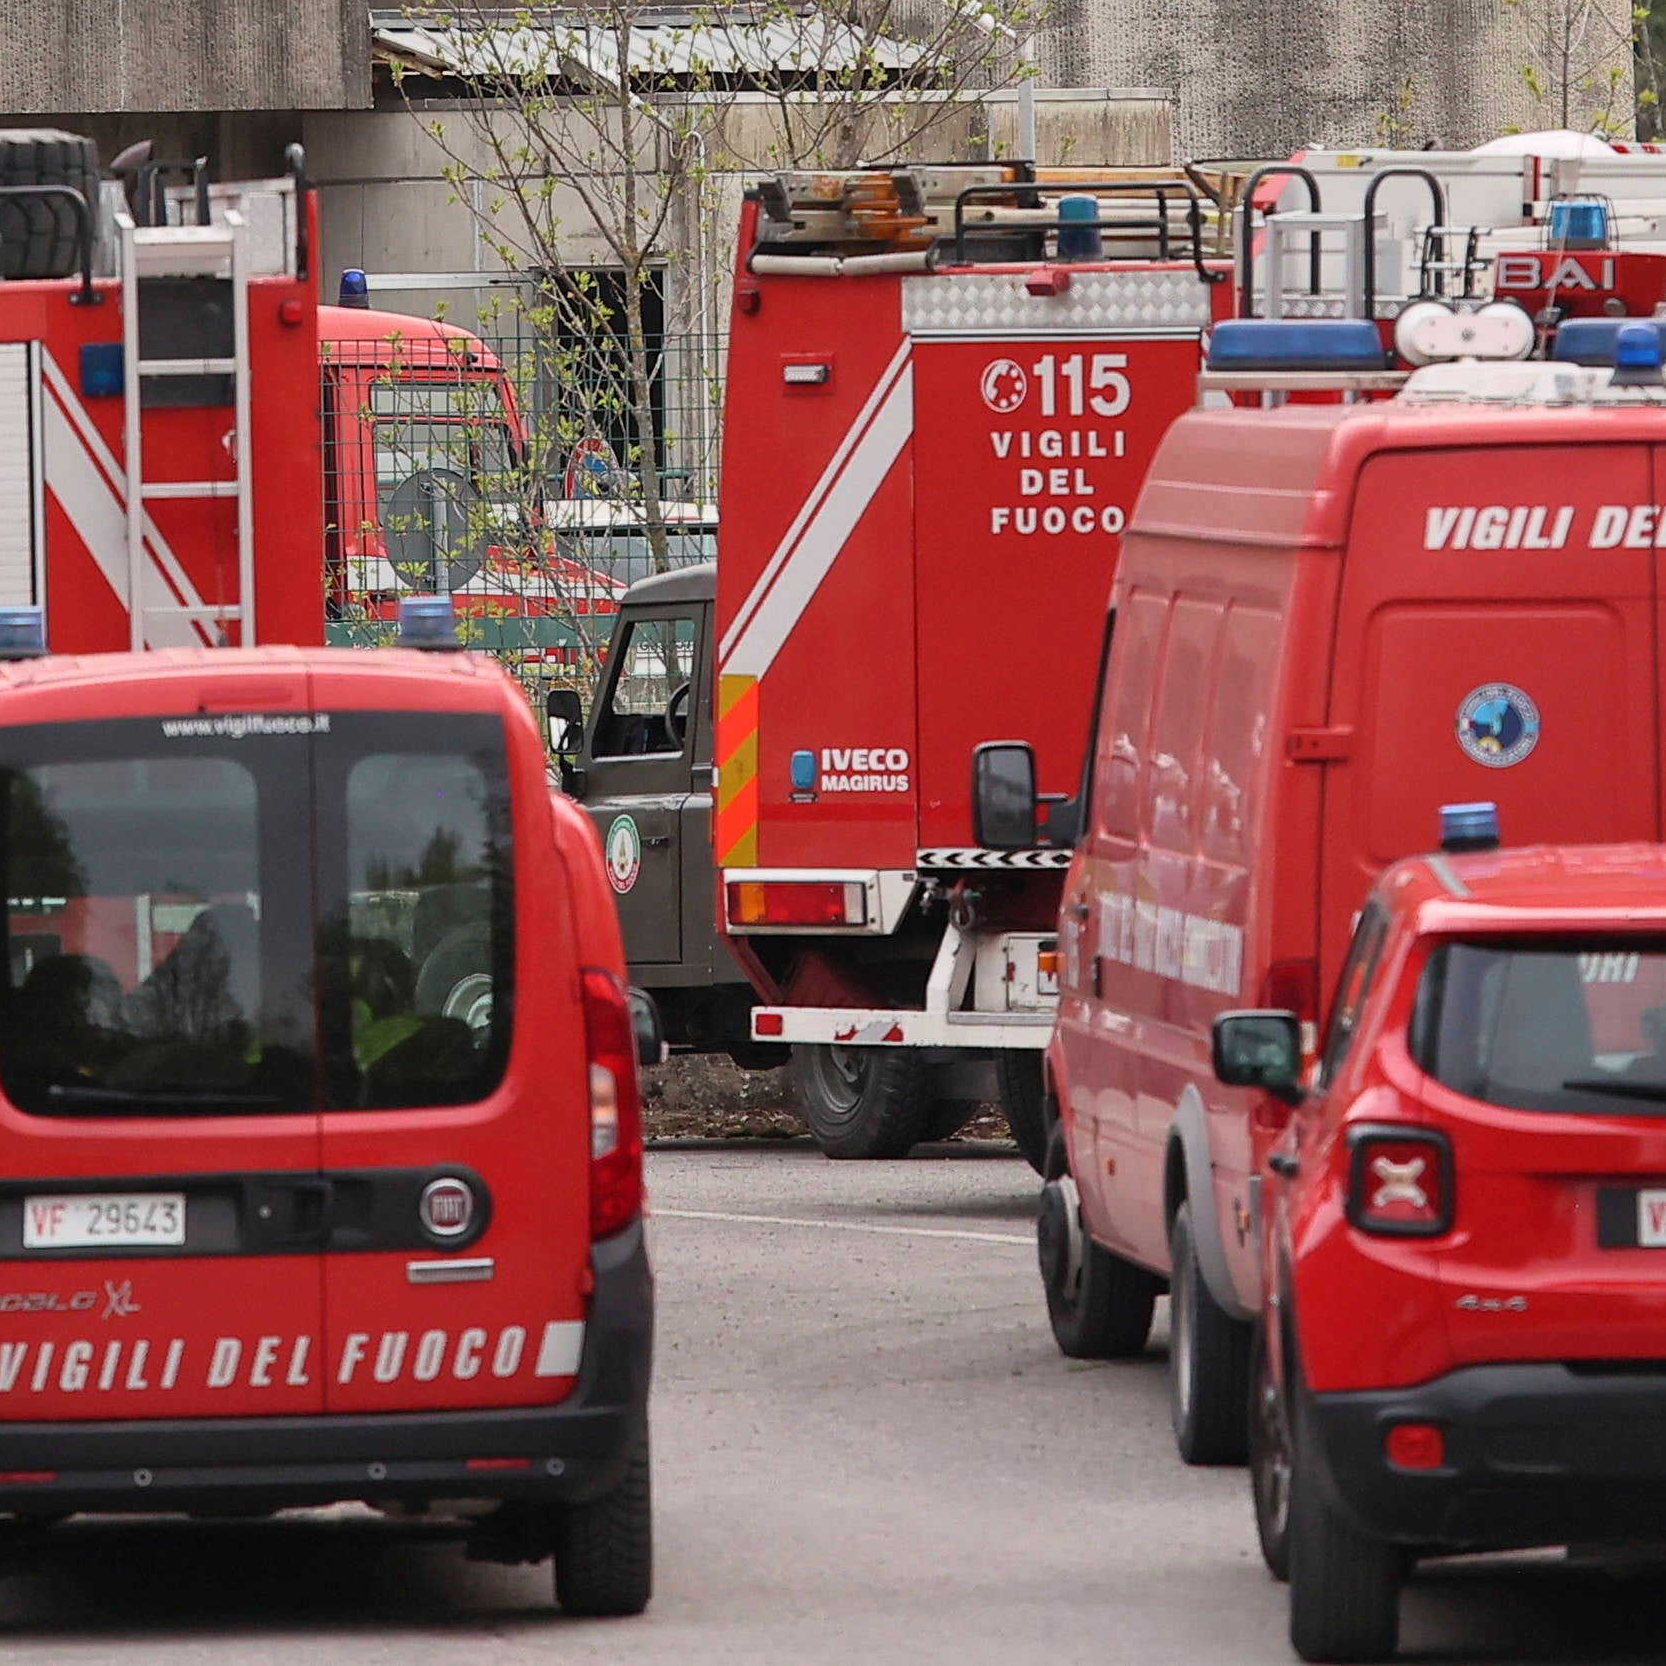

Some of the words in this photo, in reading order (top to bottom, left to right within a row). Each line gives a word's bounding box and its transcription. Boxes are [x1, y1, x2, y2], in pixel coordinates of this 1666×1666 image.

[1499, 256, 1615, 290] BAI
[1033, 354, 1131, 417] 115
[990, 430, 1125, 458] VIGILI
[1020, 468, 1094, 496] DEL
[991, 506, 1125, 534] FUOCO
[1424, 506, 1575, 550] VIGILI
[821, 748, 909, 771] IVECO
[821, 774, 910, 792] MAGIRUS
[31, 1203, 67, 1237] VF
[87, 1200, 178, 1235] 29643
[207, 1335, 311, 1388] DEL
[337, 1326, 526, 1384] FUOCO
